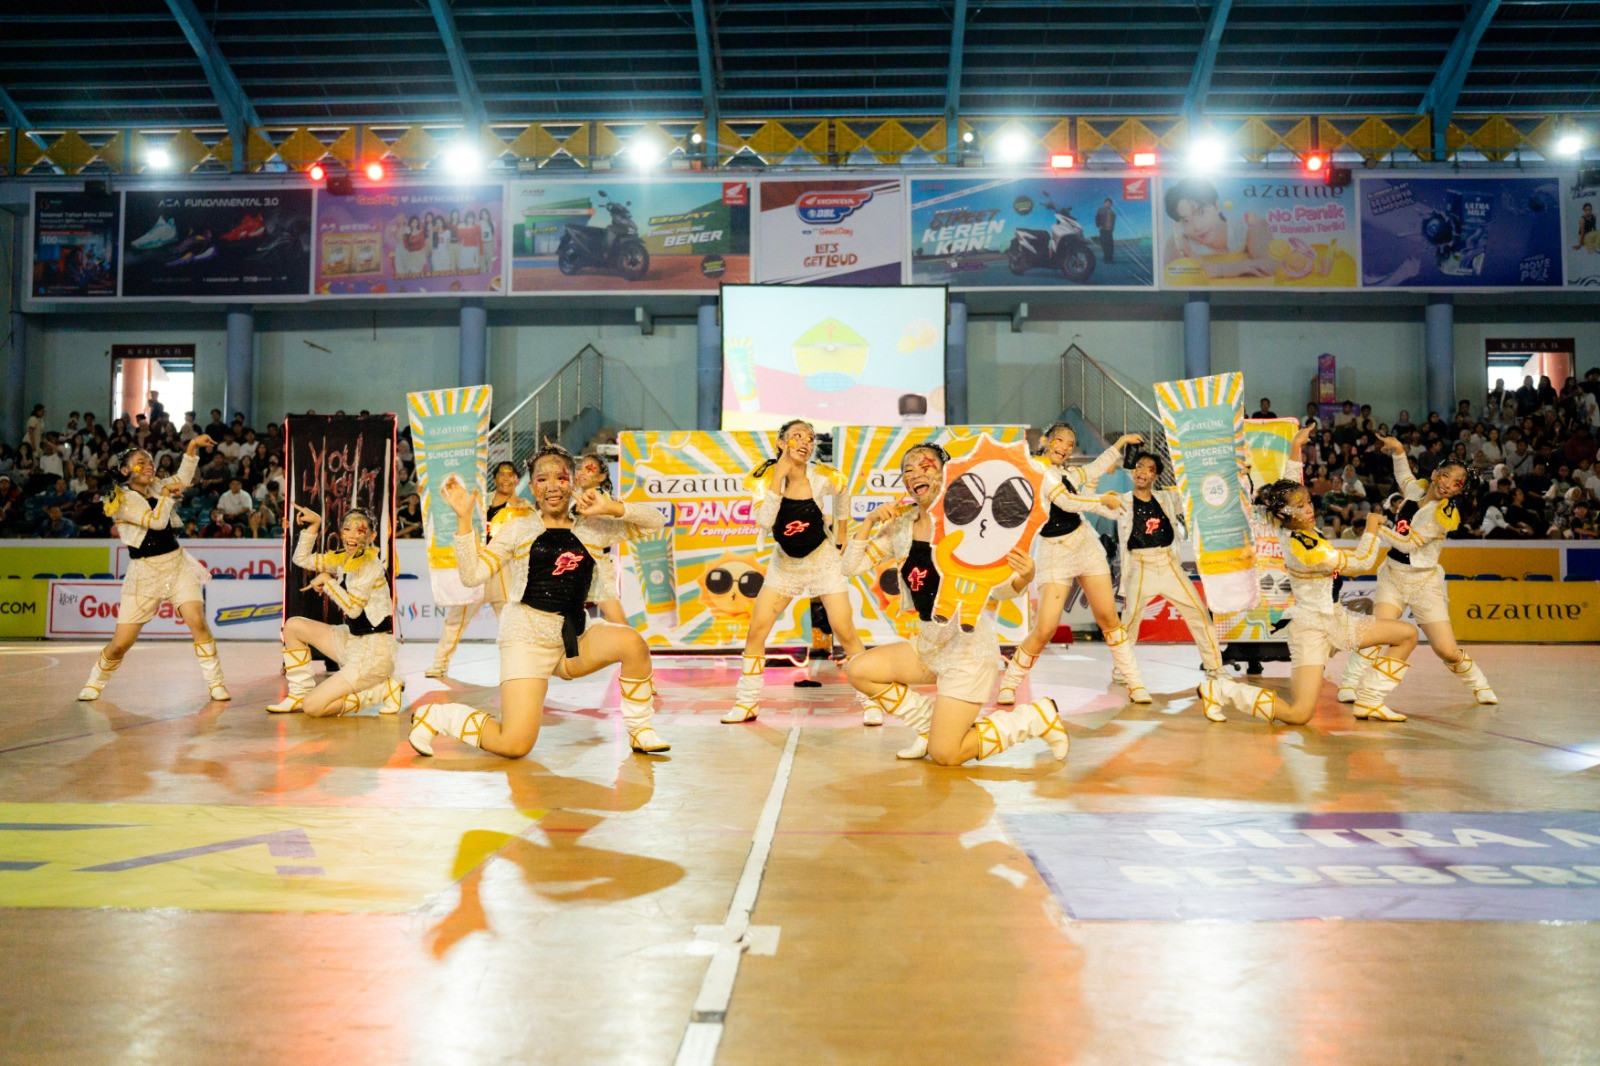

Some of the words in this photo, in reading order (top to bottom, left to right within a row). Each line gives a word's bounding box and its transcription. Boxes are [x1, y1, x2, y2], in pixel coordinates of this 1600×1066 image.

[184, 198, 262, 207] FUNDAMENTAL
[817, 209, 836, 218] DBL
[1268, 208, 1292, 223] No
[1294, 202, 1345, 222] Panik
[663, 229, 724, 248] BENER
[922, 219, 1006, 243] KEREN
[815, 243, 840, 254] LET'S
[934, 234, 994, 255] KAN!
[803, 255, 824, 268] GET
[826, 253, 858, 268] LOUD
[428, 448, 475, 460] SUNSCREEN
[1185, 446, 1233, 459] SUNSCREEN
[444, 459, 460, 467] GEL
[1203, 458, 1219, 466] GEL
[648, 476, 749, 494] azarin
[1210, 484, 1224, 495] 45
[677, 500, 756, 536] DANC
[701, 525, 760, 542] Competitio
[1144, 829, 1551, 848] ULTRA
